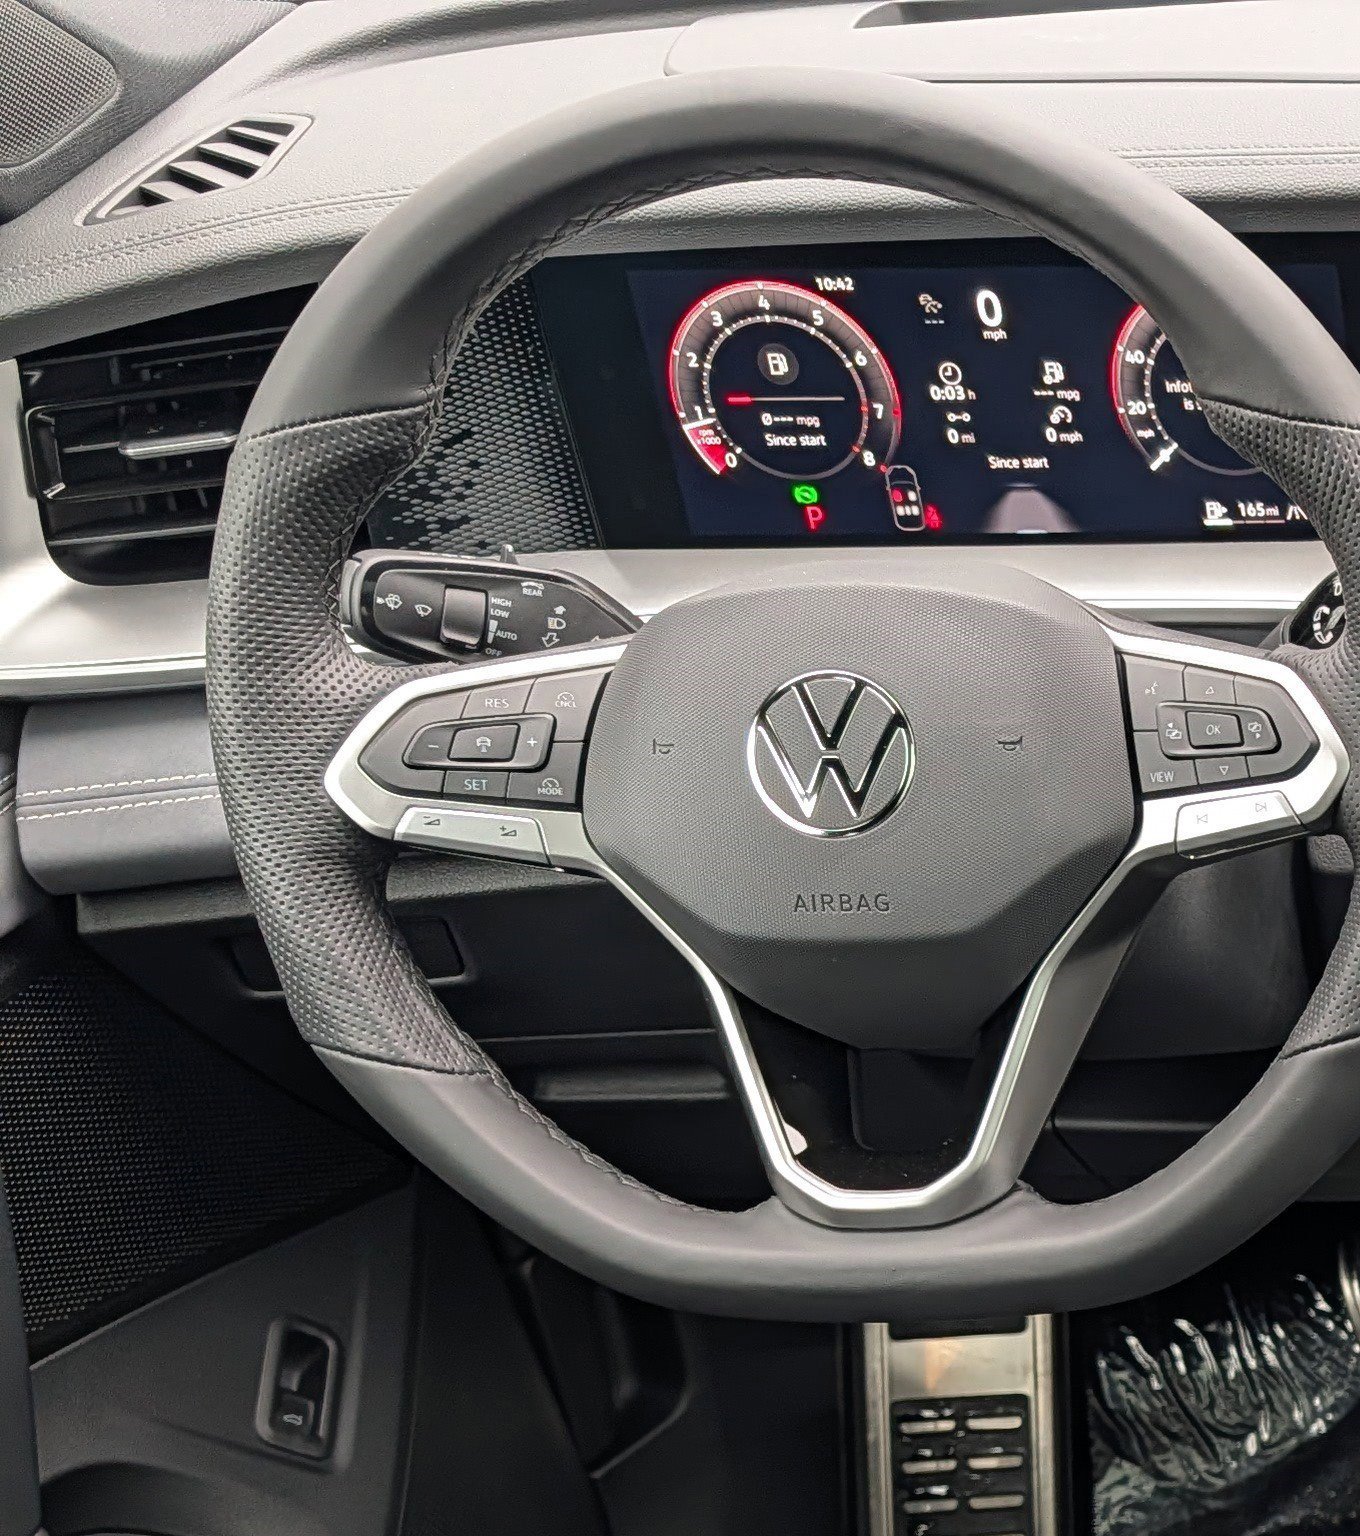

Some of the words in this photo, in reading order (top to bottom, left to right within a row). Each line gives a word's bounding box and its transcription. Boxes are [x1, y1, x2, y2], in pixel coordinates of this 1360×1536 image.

[815, 276, 854, 291] 10:42
[758, 296, 770, 310] 4
[976, 289, 1003, 327] 0
[711, 311, 723, 327] 3
[813, 310, 824, 326] 5
[982, 329, 1008, 341] mph
[687, 353, 699, 367] 2
[855, 351, 867, 366] 6
[1125, 350, 1145, 365] 40
[930, 385, 965, 400] 0:03
[968, 389, 976, 400] h
[1165, 380, 1193, 393] Info
[1056, 390, 1080, 401] mpg
[694, 406, 703, 420] 1
[873, 403, 884, 418] 7
[1127, 401, 1147, 415] 20
[796, 414, 821, 427] mpg
[765, 434, 797, 447] Since
[799, 435, 827, 447] start
[947, 428, 959, 444] 0
[961, 433, 976, 444] mi
[1045, 426, 1057, 442] 0
[1059, 431, 1083, 444] mph
[1136, 429, 1155, 439] mph
[725, 453, 738, 468] 0
[862, 451, 875, 466] 8
[988, 455, 1020, 469] Since
[1022, 457, 1050, 469] start
[1238, 502, 1265, 517] 165
[804, 506, 824, 529] P
[522, 588, 543, 598] REAR
[491, 596, 512, 608] HIGH
[490, 608, 510, 619] LOW
[495, 629, 518, 641] AUTO
[484, 698, 510, 708] RES
[555, 700, 577, 708] CNCL
[1206, 723, 1222, 737] OK
[1149, 770, 1174, 784] VIEW
[464, 778, 488, 791] SET
[537, 787, 563, 796] MODE
[793, 893, 892, 913] AIRBAG
